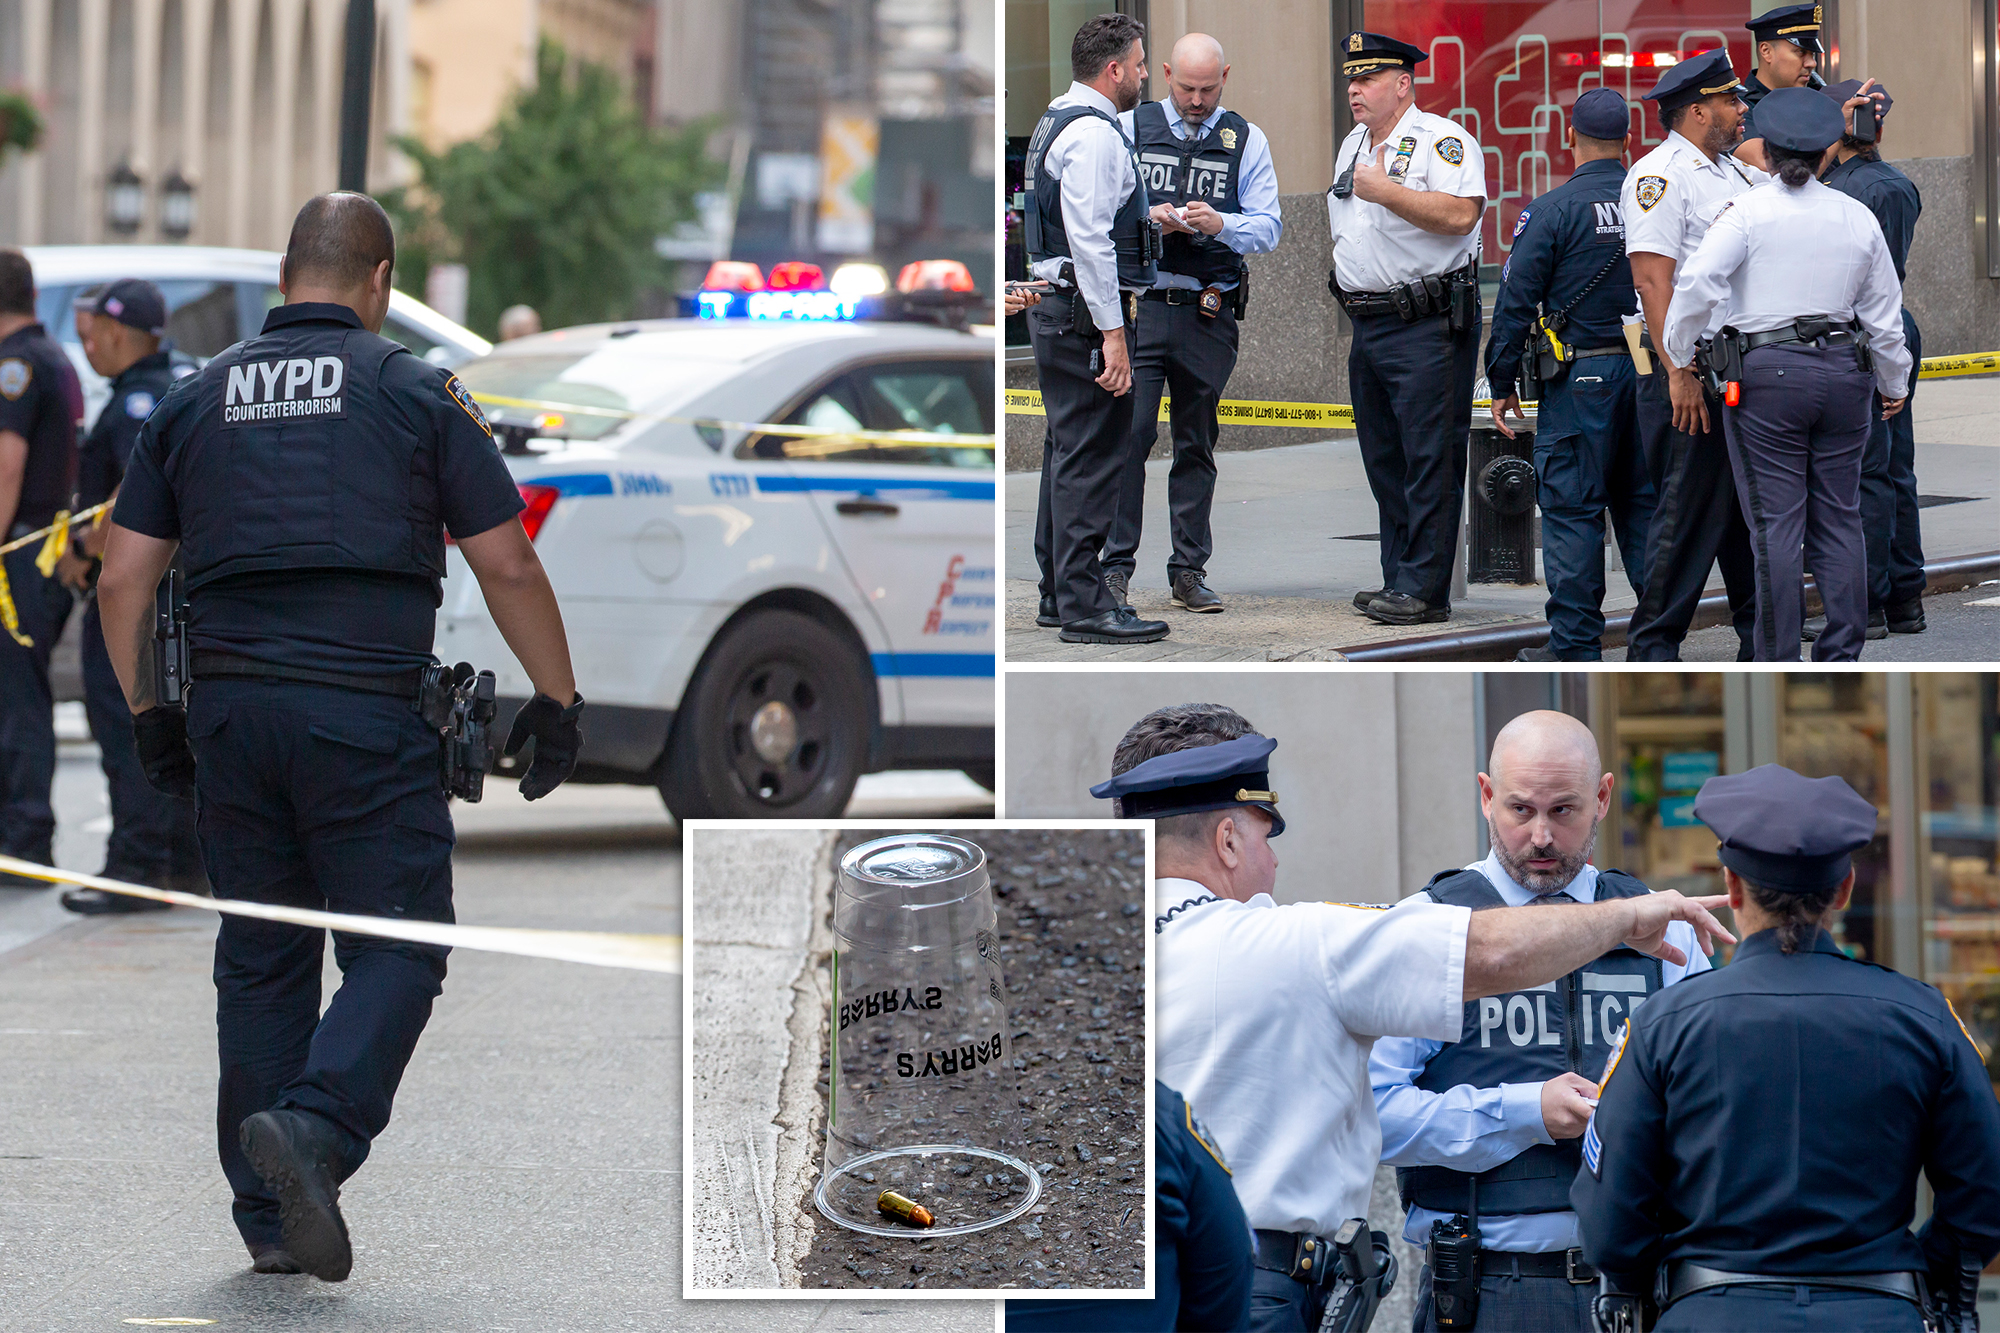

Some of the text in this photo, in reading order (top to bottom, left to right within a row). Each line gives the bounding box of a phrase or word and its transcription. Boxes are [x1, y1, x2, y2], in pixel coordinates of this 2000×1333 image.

[1139, 164, 1228, 198] POLICE
[225, 356, 344, 406] NYPD
[1010, 394, 1030, 407] CRIME
[225, 397, 341, 422] COUNTERTERRORISM
[1234, 406, 1253, 417] CRIME
[1255, 406, 1274, 420] (8477)
[1274, 408, 1322, 420] 1-800-577-TIPS
[1328, 408, 1355, 419] toppers
